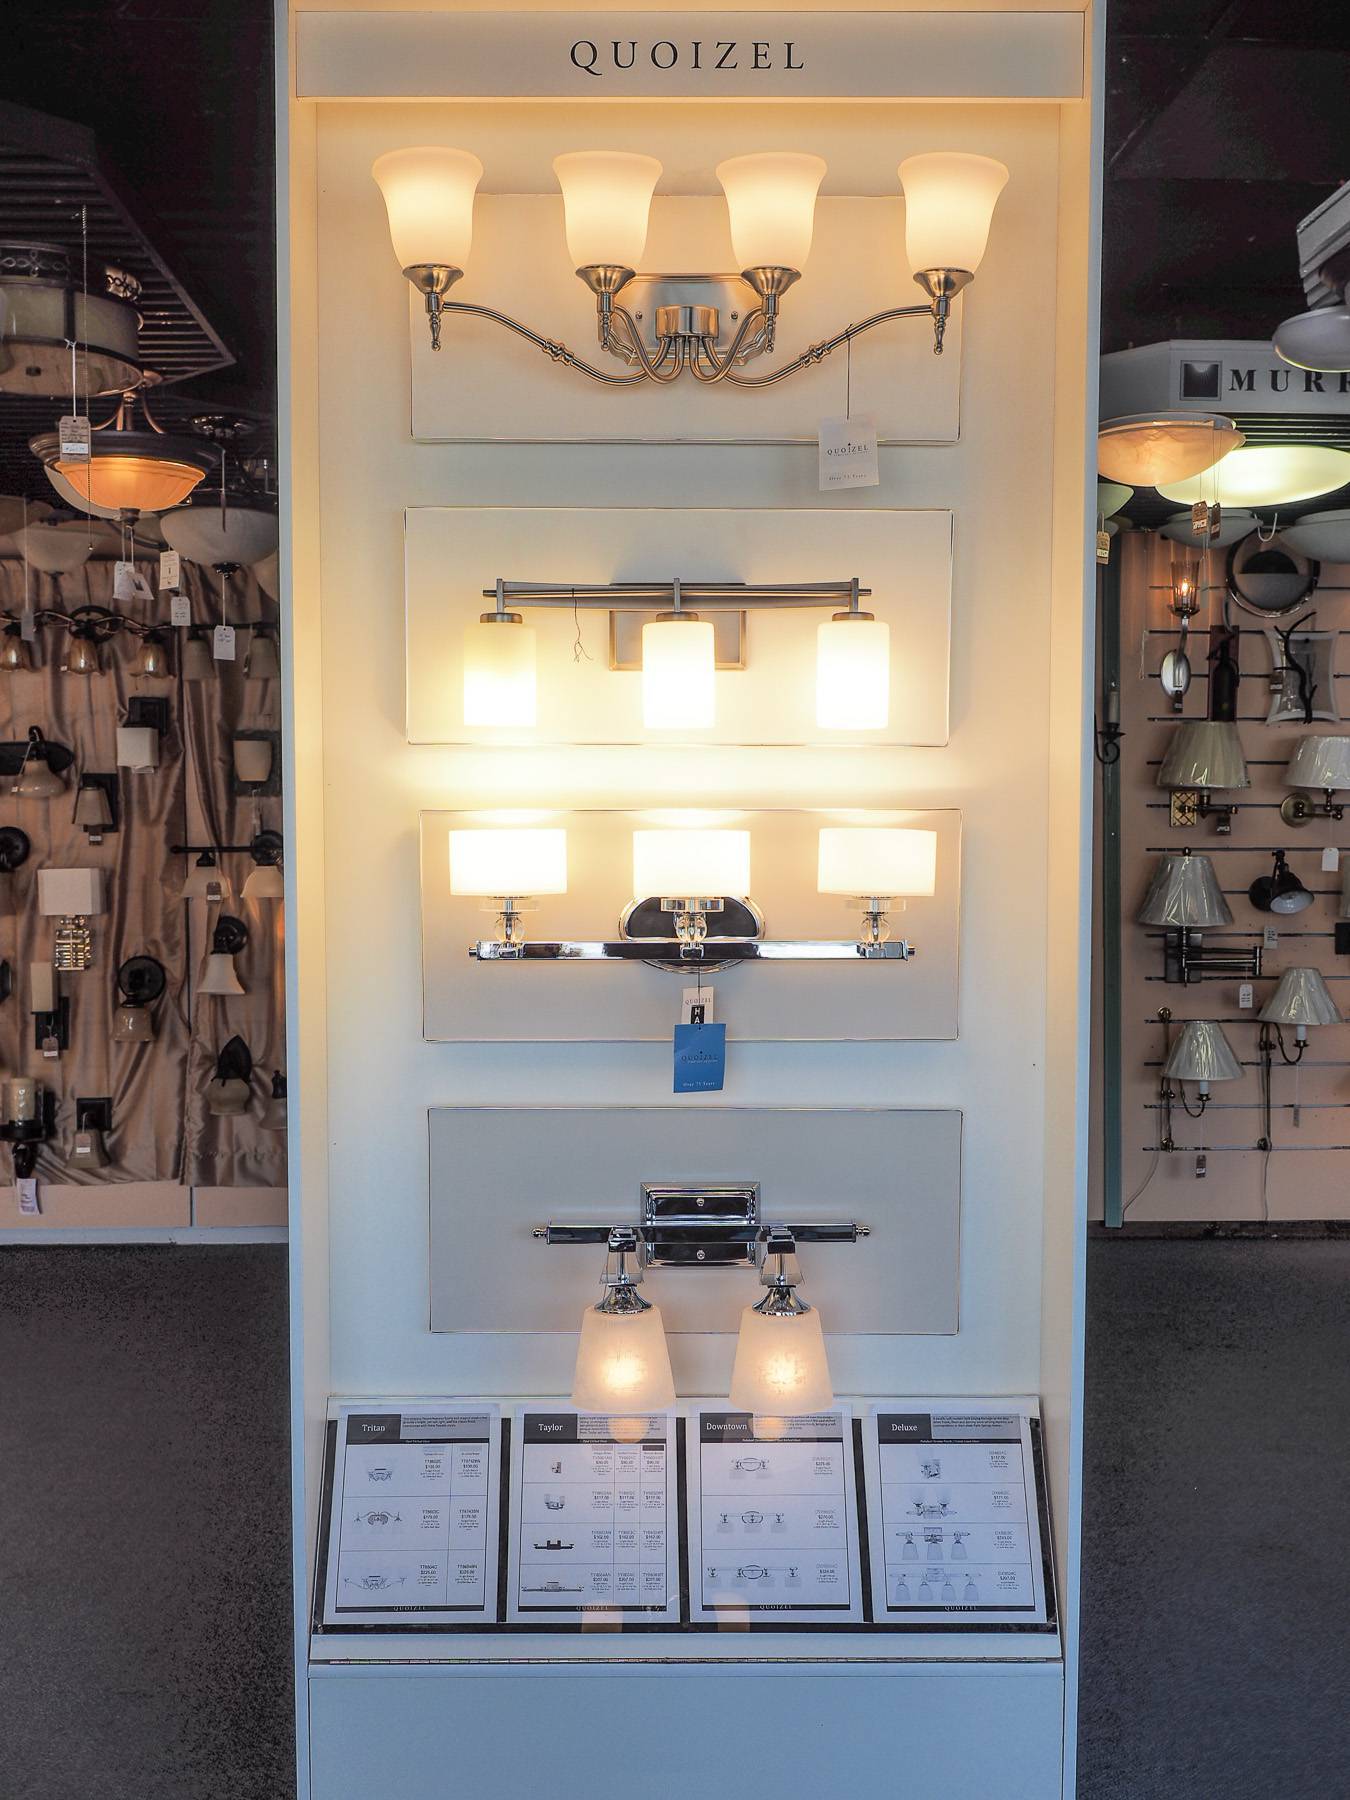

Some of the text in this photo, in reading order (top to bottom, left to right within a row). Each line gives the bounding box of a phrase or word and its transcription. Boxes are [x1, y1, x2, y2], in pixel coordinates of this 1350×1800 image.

[570, 40, 805, 76] QUOIZEL
[362, 1424, 386, 1432] Tritan
[538, 1423, 563, 1433] Taylor
[706, 1422, 747, 1431] Downtown
[891, 1423, 918, 1432] Deluxe
